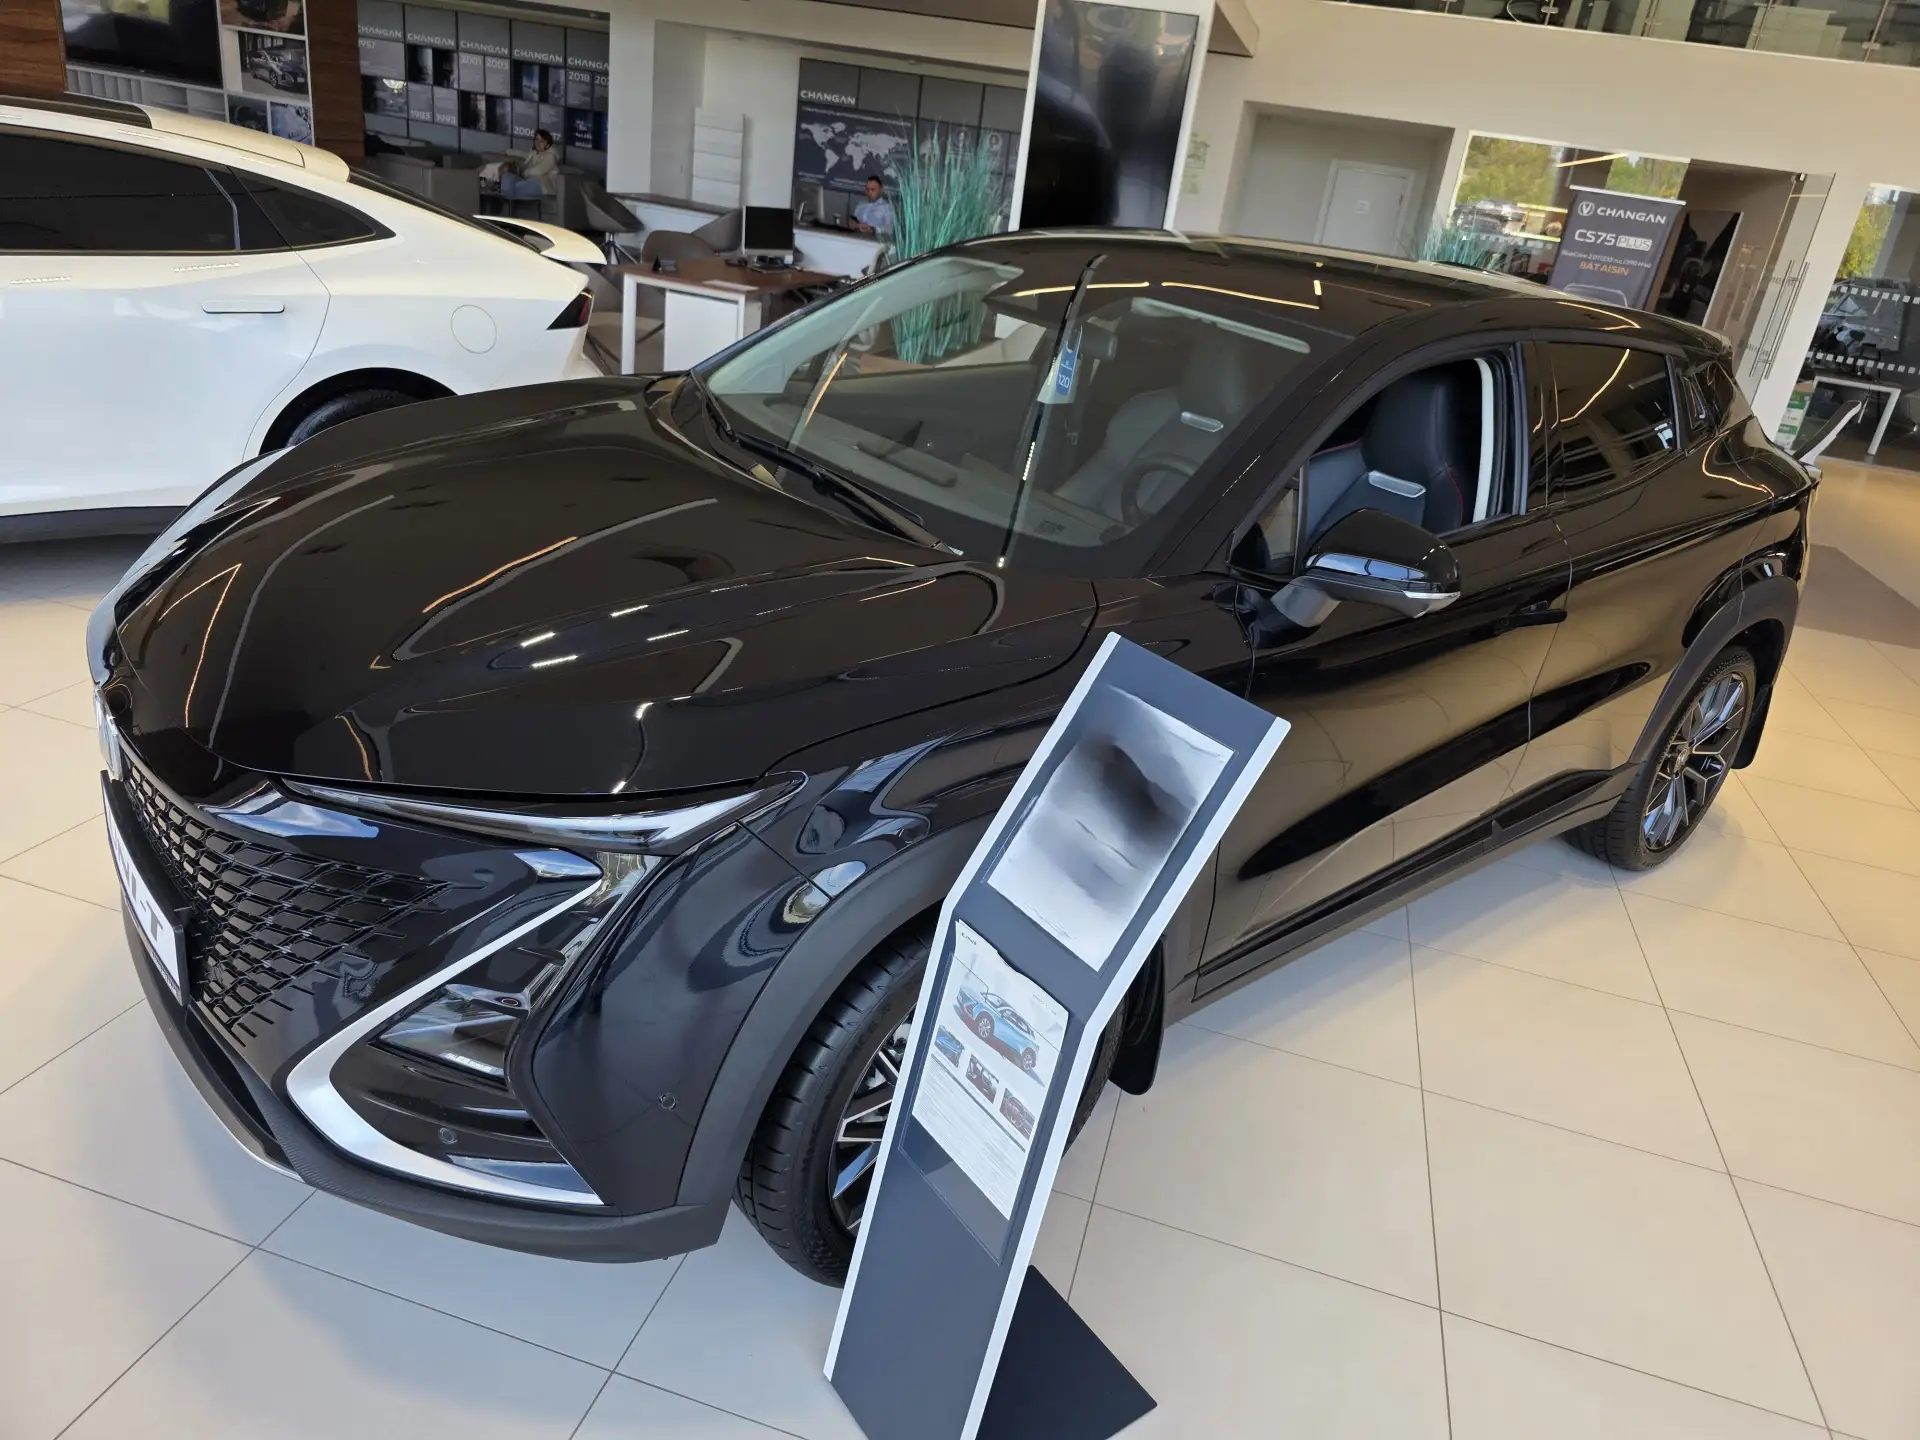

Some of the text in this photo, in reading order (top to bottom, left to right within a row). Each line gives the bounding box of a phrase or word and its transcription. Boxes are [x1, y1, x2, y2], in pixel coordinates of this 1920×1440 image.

[407, 33, 455, 47] CHANGAN
[460, 40, 508, 56] CHANGAN
[514, 49, 563, 63] CHANGAN
[568, 57, 610, 71] CHANGA
[567, 71, 590, 83] 2018
[595, 75, 609, 86] 20
[800, 90, 856, 105] CHANGAN
[1597, 207, 1666, 224] CHANGAN
[1574, 229, 1652, 251] CS75 PLUS
[1600, 264, 1629, 276] AISIN
